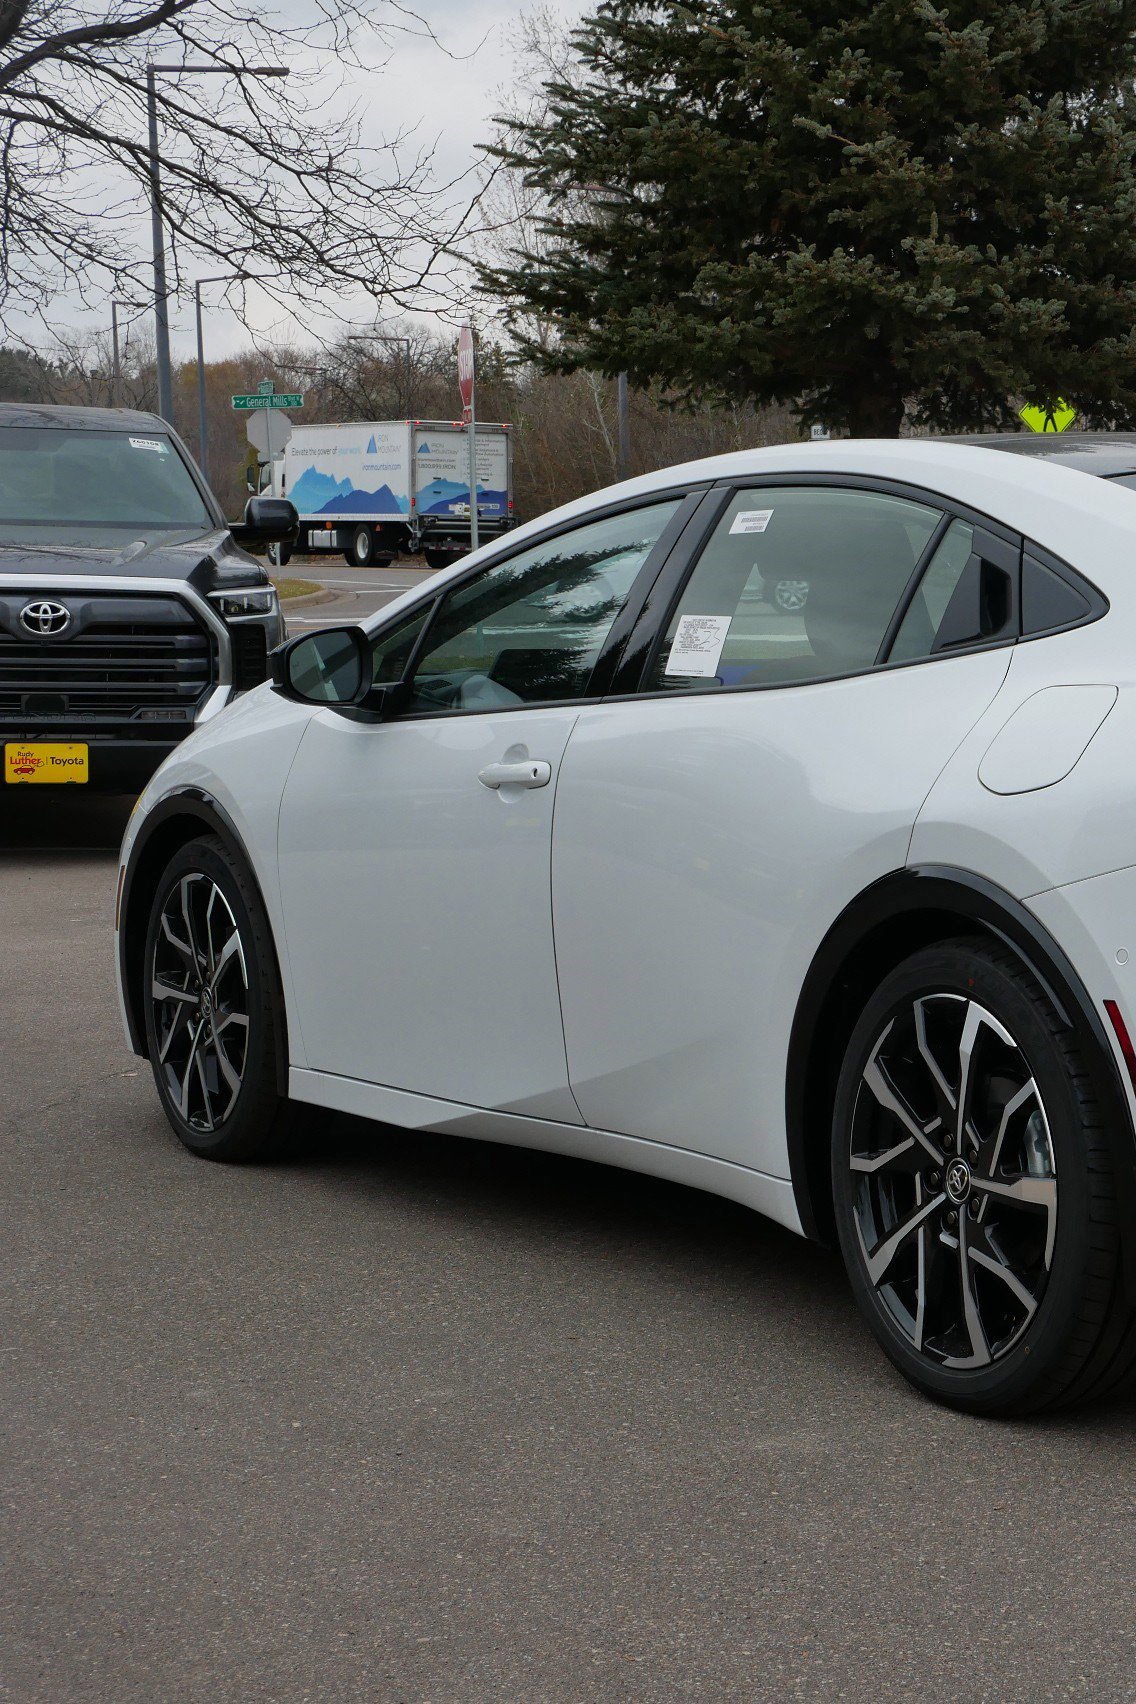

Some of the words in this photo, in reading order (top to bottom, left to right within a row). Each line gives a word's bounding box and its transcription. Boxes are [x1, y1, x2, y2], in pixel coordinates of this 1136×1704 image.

[246, 396, 272, 407] General
[272, 397, 288, 406] Mills
[291, 447, 308, 456] Elevate
[308, 447, 317, 456] the
[316, 448, 333, 458] power
[332, 446, 339, 455] of
[362, 463, 402, 471] ironmountain.com
[9, 756, 42, 765] Luther
[49, 756, 84, 767] Toyota
